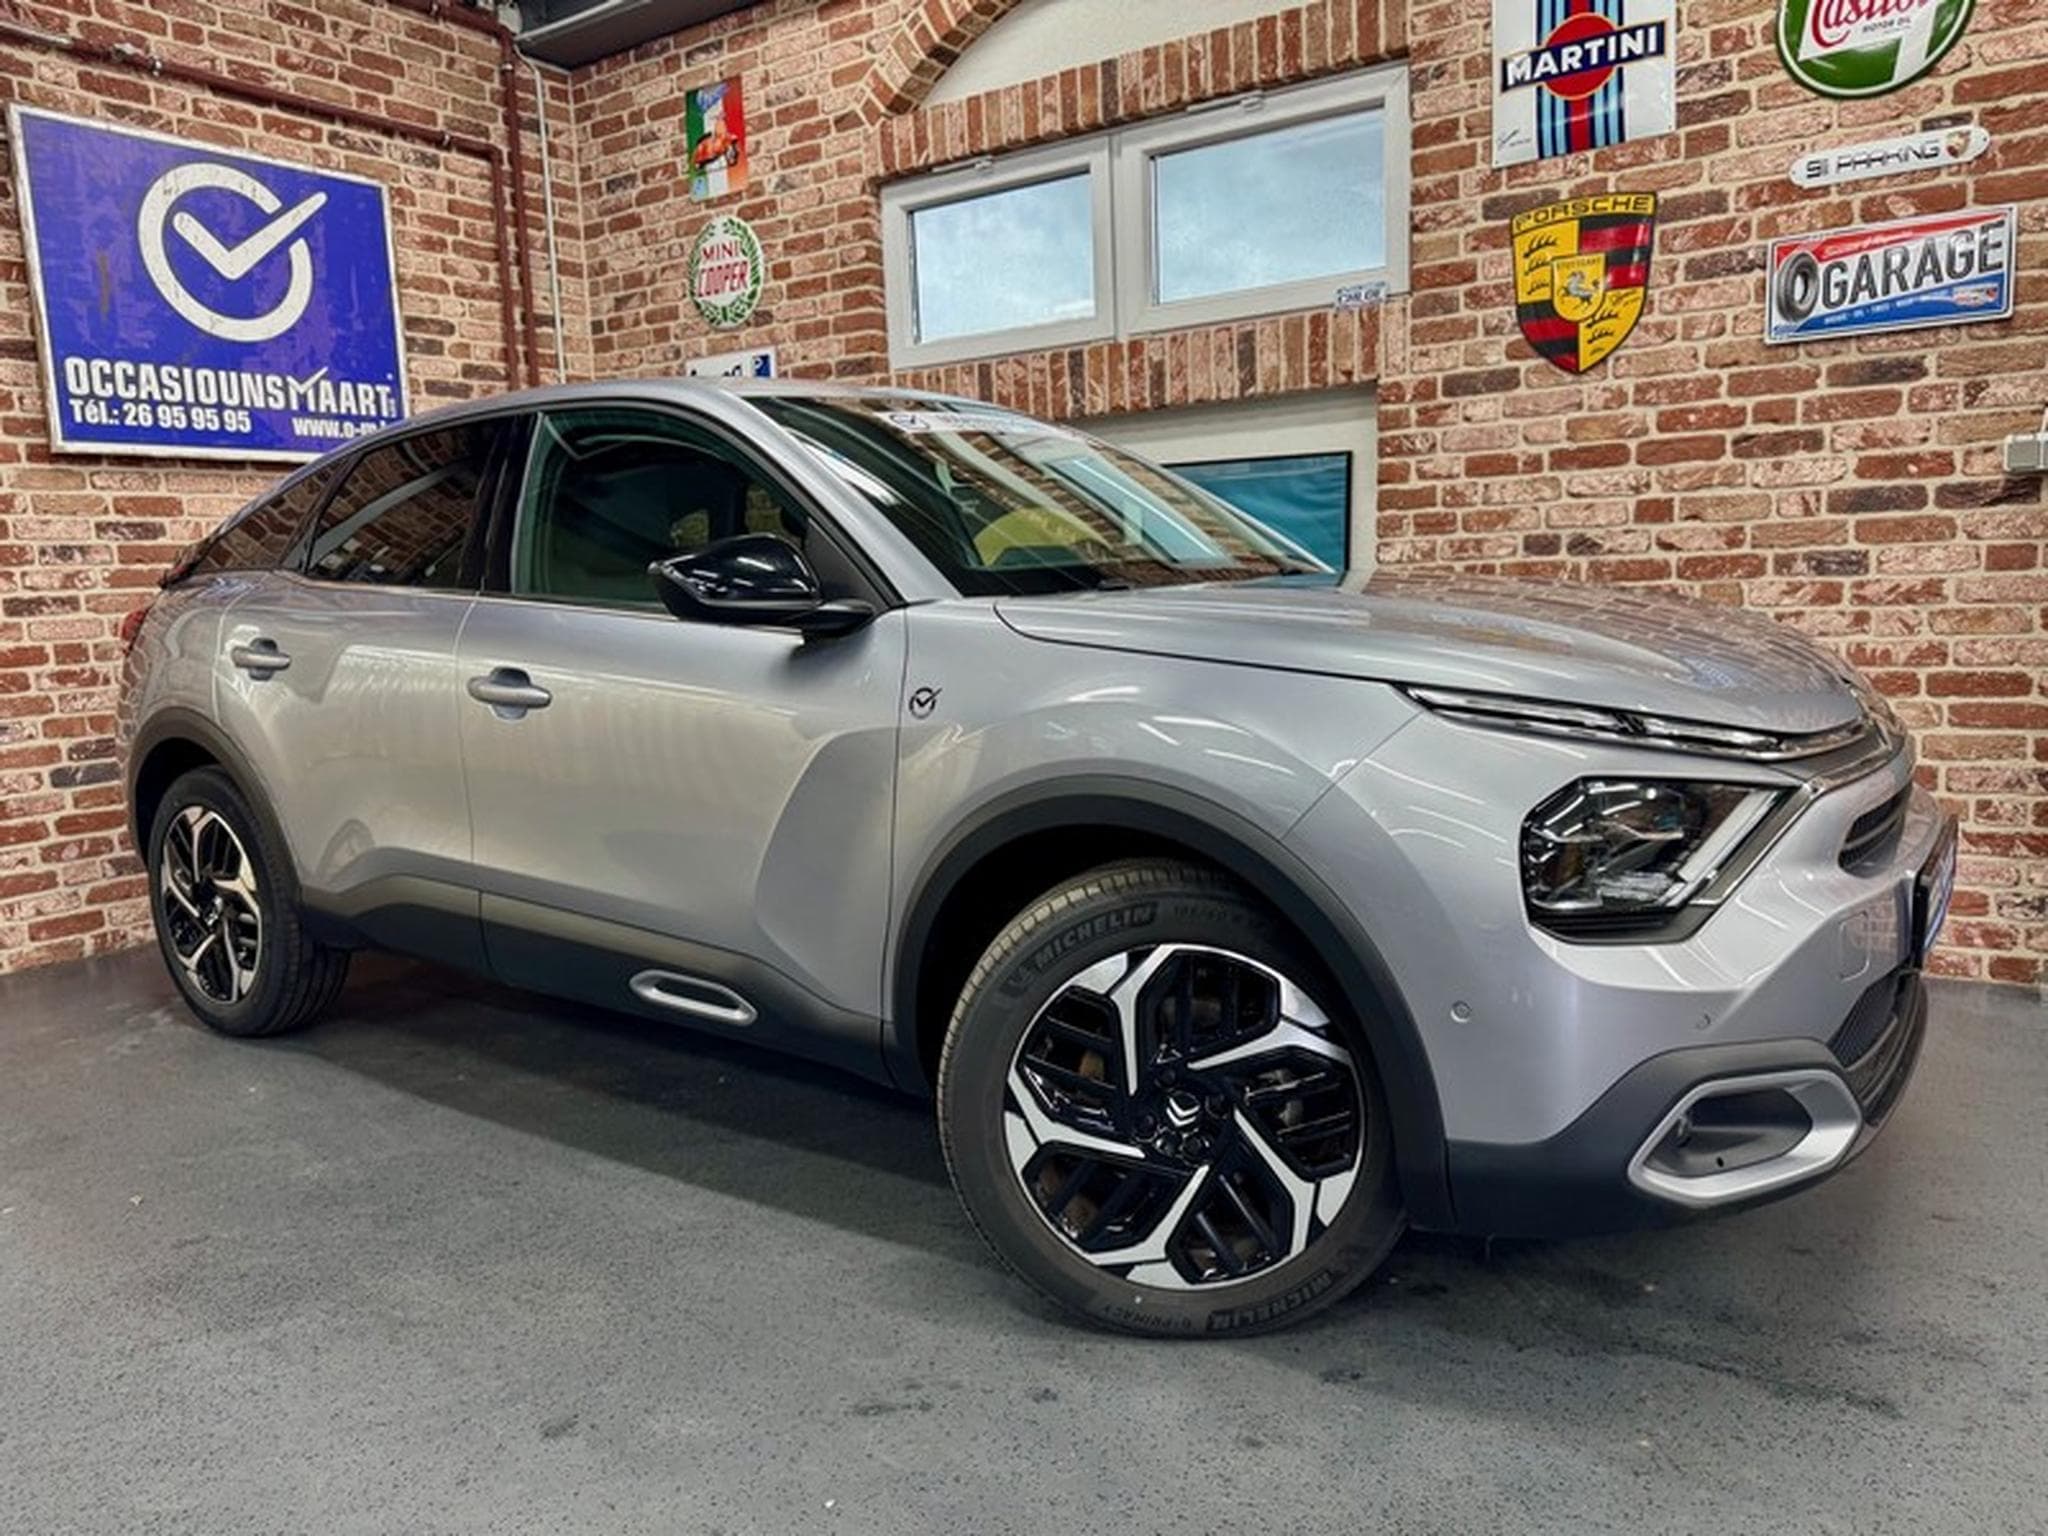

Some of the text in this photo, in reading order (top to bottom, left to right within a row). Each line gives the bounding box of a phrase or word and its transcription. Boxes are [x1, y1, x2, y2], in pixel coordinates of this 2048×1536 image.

[1506, 27, 1658, 86] MARTINI
[1836, 140, 1941, 175] PARKING
[1516, 196, 1649, 232] PORSCHE
[702, 240, 739, 264] MINI
[698, 260, 748, 298] COOPER
[64, 356, 390, 418] OCCASIOUNSMAART
[69, 399, 252, 433] Tél.: 26 95 95 95
[1036, 905, 1153, 970] MICHELIN
[1212, 1270, 1333, 1330] MICHELIN
